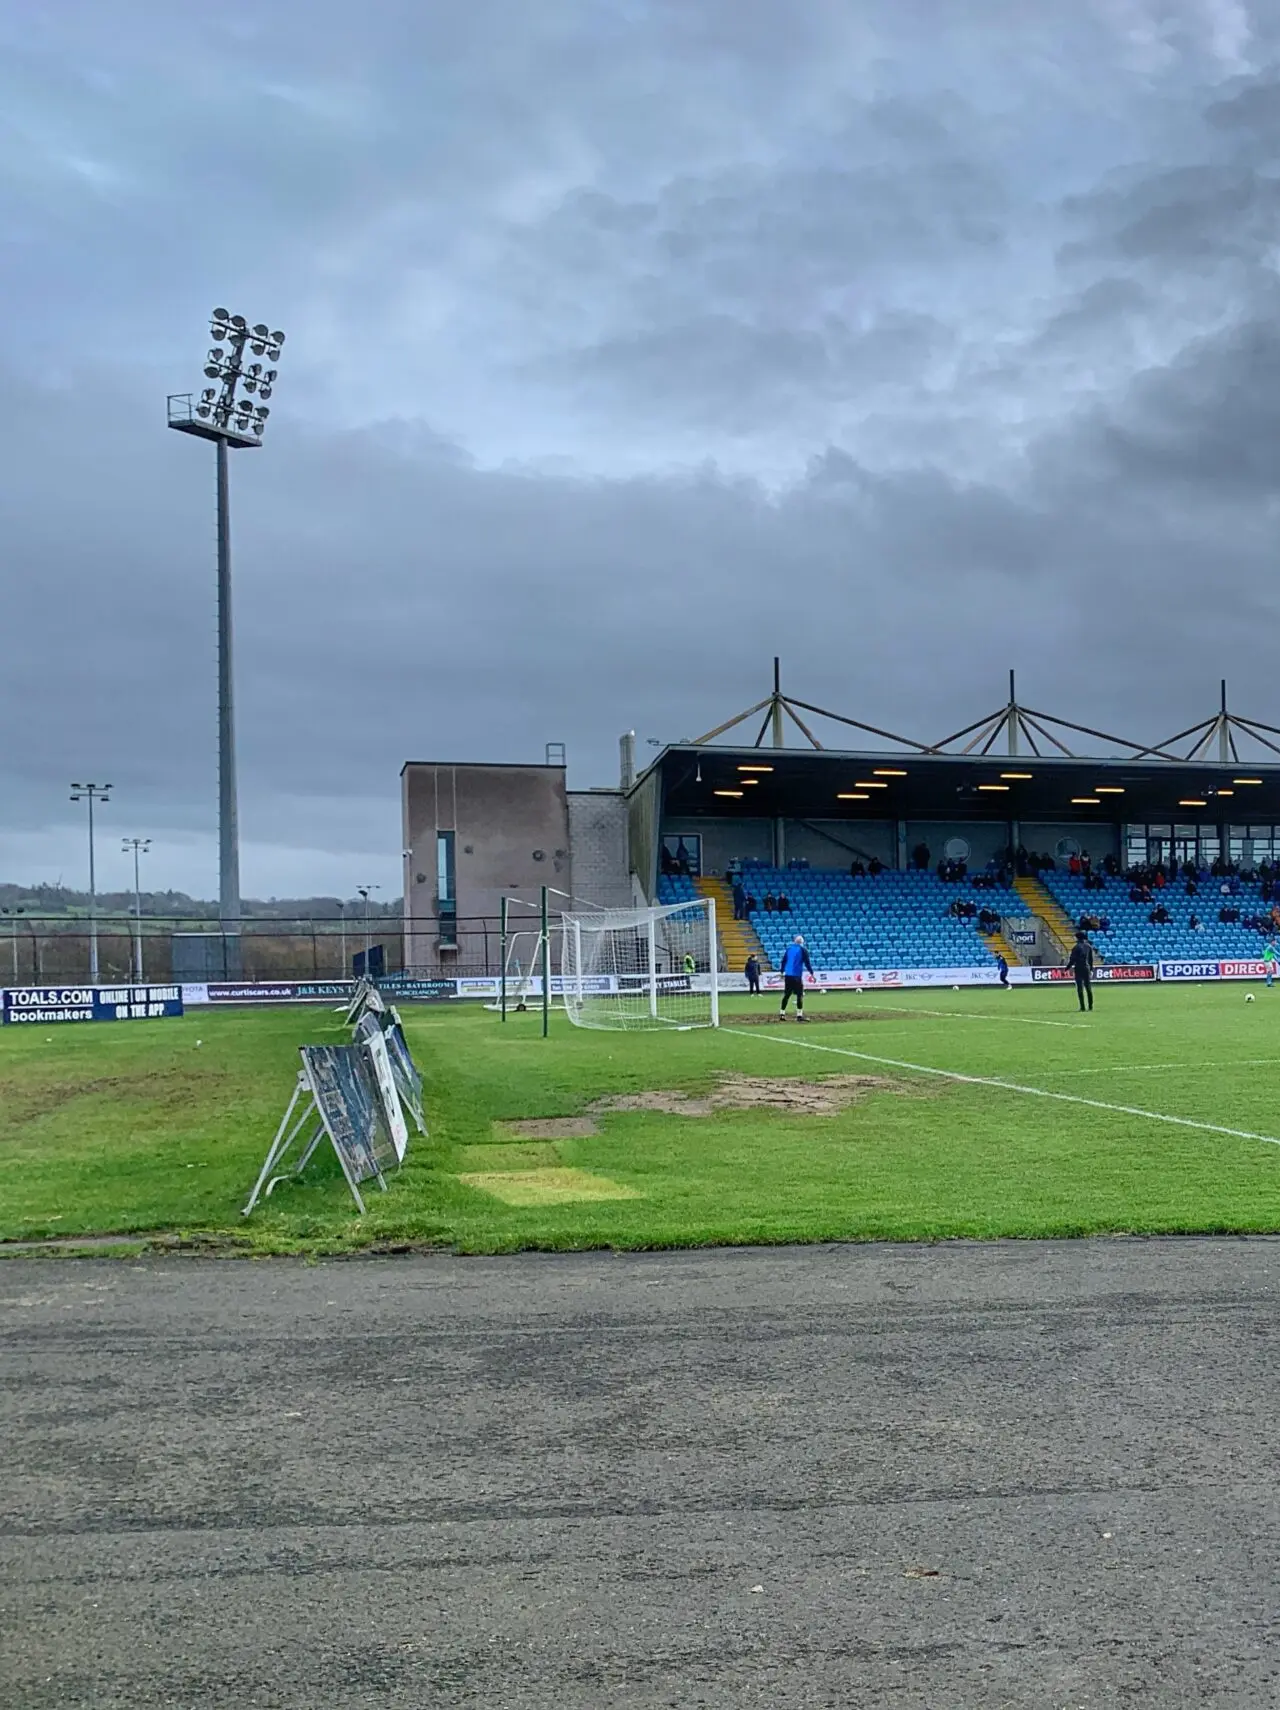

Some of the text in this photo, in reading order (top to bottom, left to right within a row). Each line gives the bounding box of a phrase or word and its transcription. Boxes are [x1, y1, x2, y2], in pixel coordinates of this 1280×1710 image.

[1096, 968, 1153, 979] BetMcLean
[1165, 963, 1274, 976] SPORTS DIREC
[100, 989, 128, 1004] ONLINE
[135, 989, 147, 1002] ON
[149, 987, 179, 1001] MOBILE
[208, 988, 292, 998] www.curtiscars.co.uk
[316, 985, 344, 995] KEYS
[9, 991, 93, 1005] TOALS.COM
[10, 1008, 93, 1021] bookmakers
[116, 1002, 165, 1018] ON THE APP
